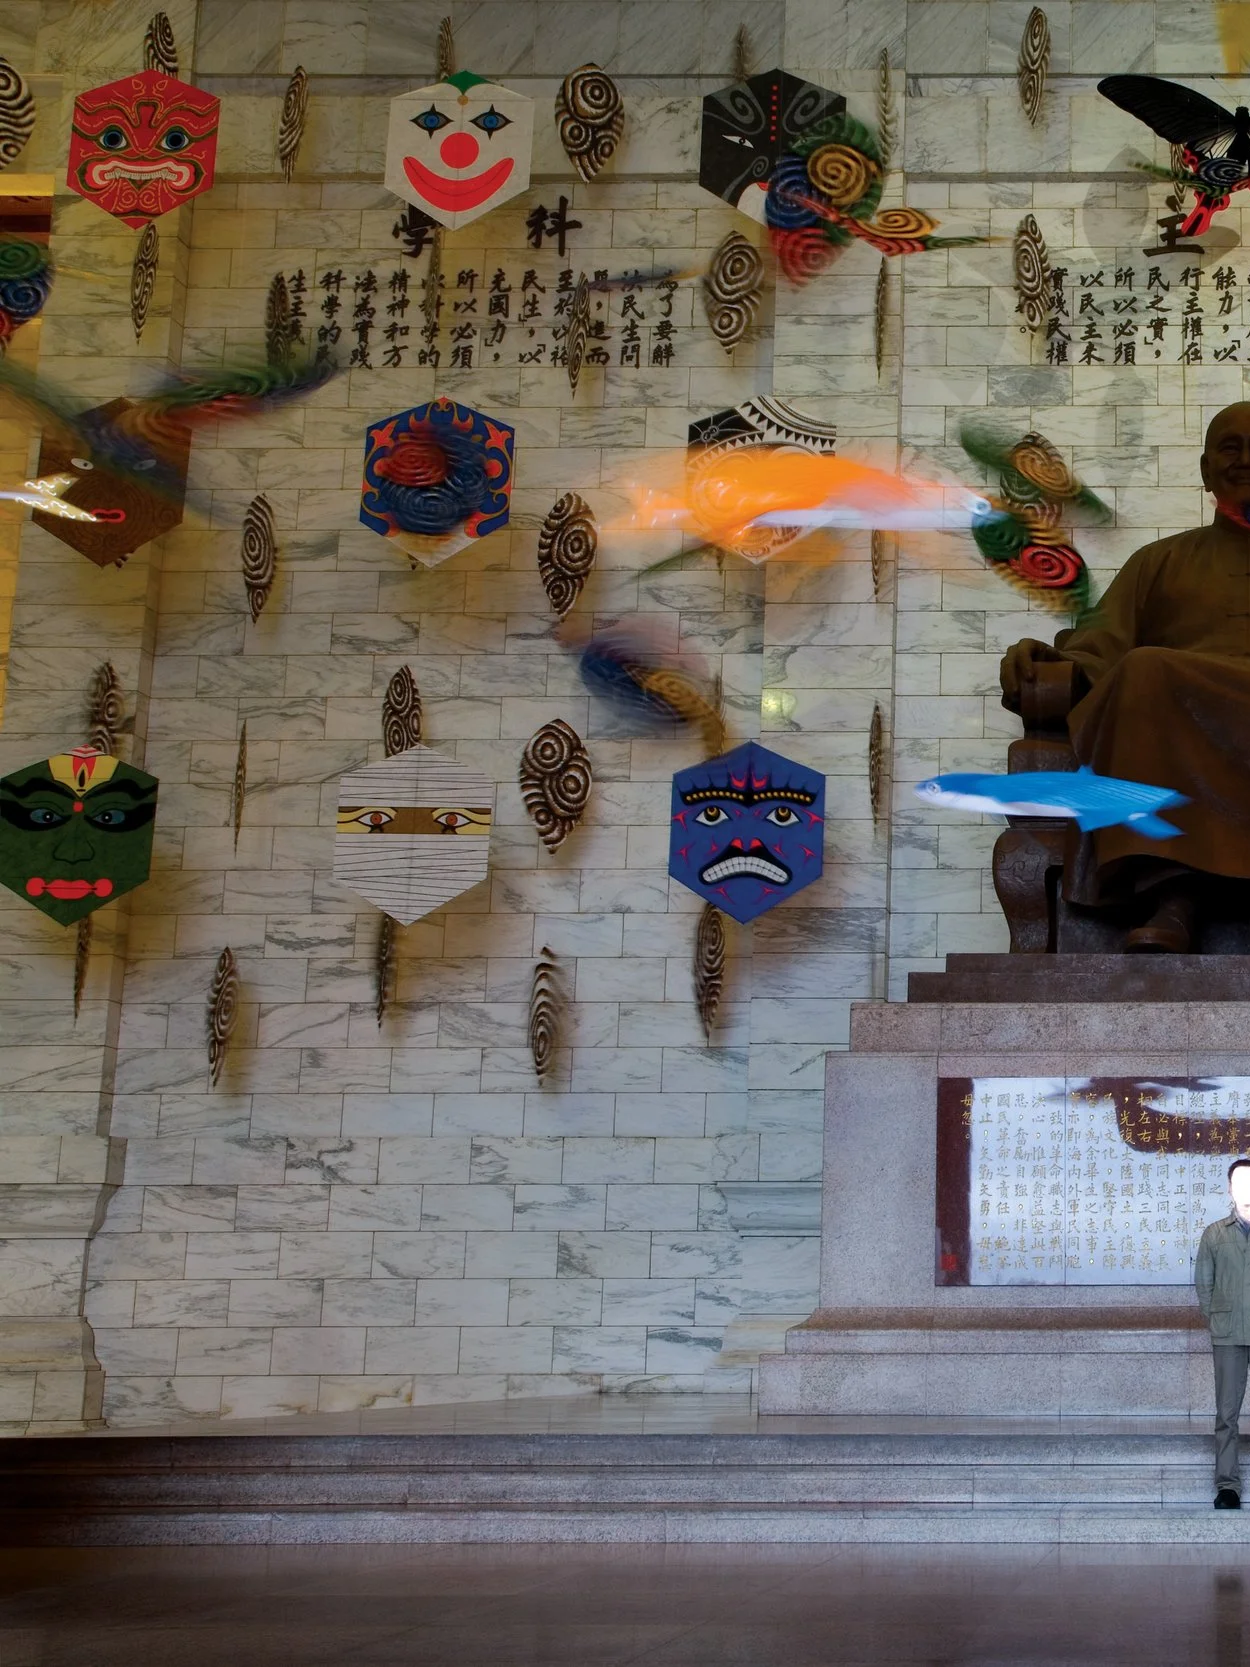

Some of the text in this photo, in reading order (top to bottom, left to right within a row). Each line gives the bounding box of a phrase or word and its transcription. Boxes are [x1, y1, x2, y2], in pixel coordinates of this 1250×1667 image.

[382, 268, 411, 368] 精神和方
[450, 269, 478, 369] 所以必須
[1046, 267, 1072, 366] 實踐民權
[1079, 270, 1105, 366] 以民主來
[1112, 267, 1138, 366] 所以必須
[1177, 267, 1205, 365] 行主權在
[1137, 1092, 1155, 1273] 相左右實踐三民主義
